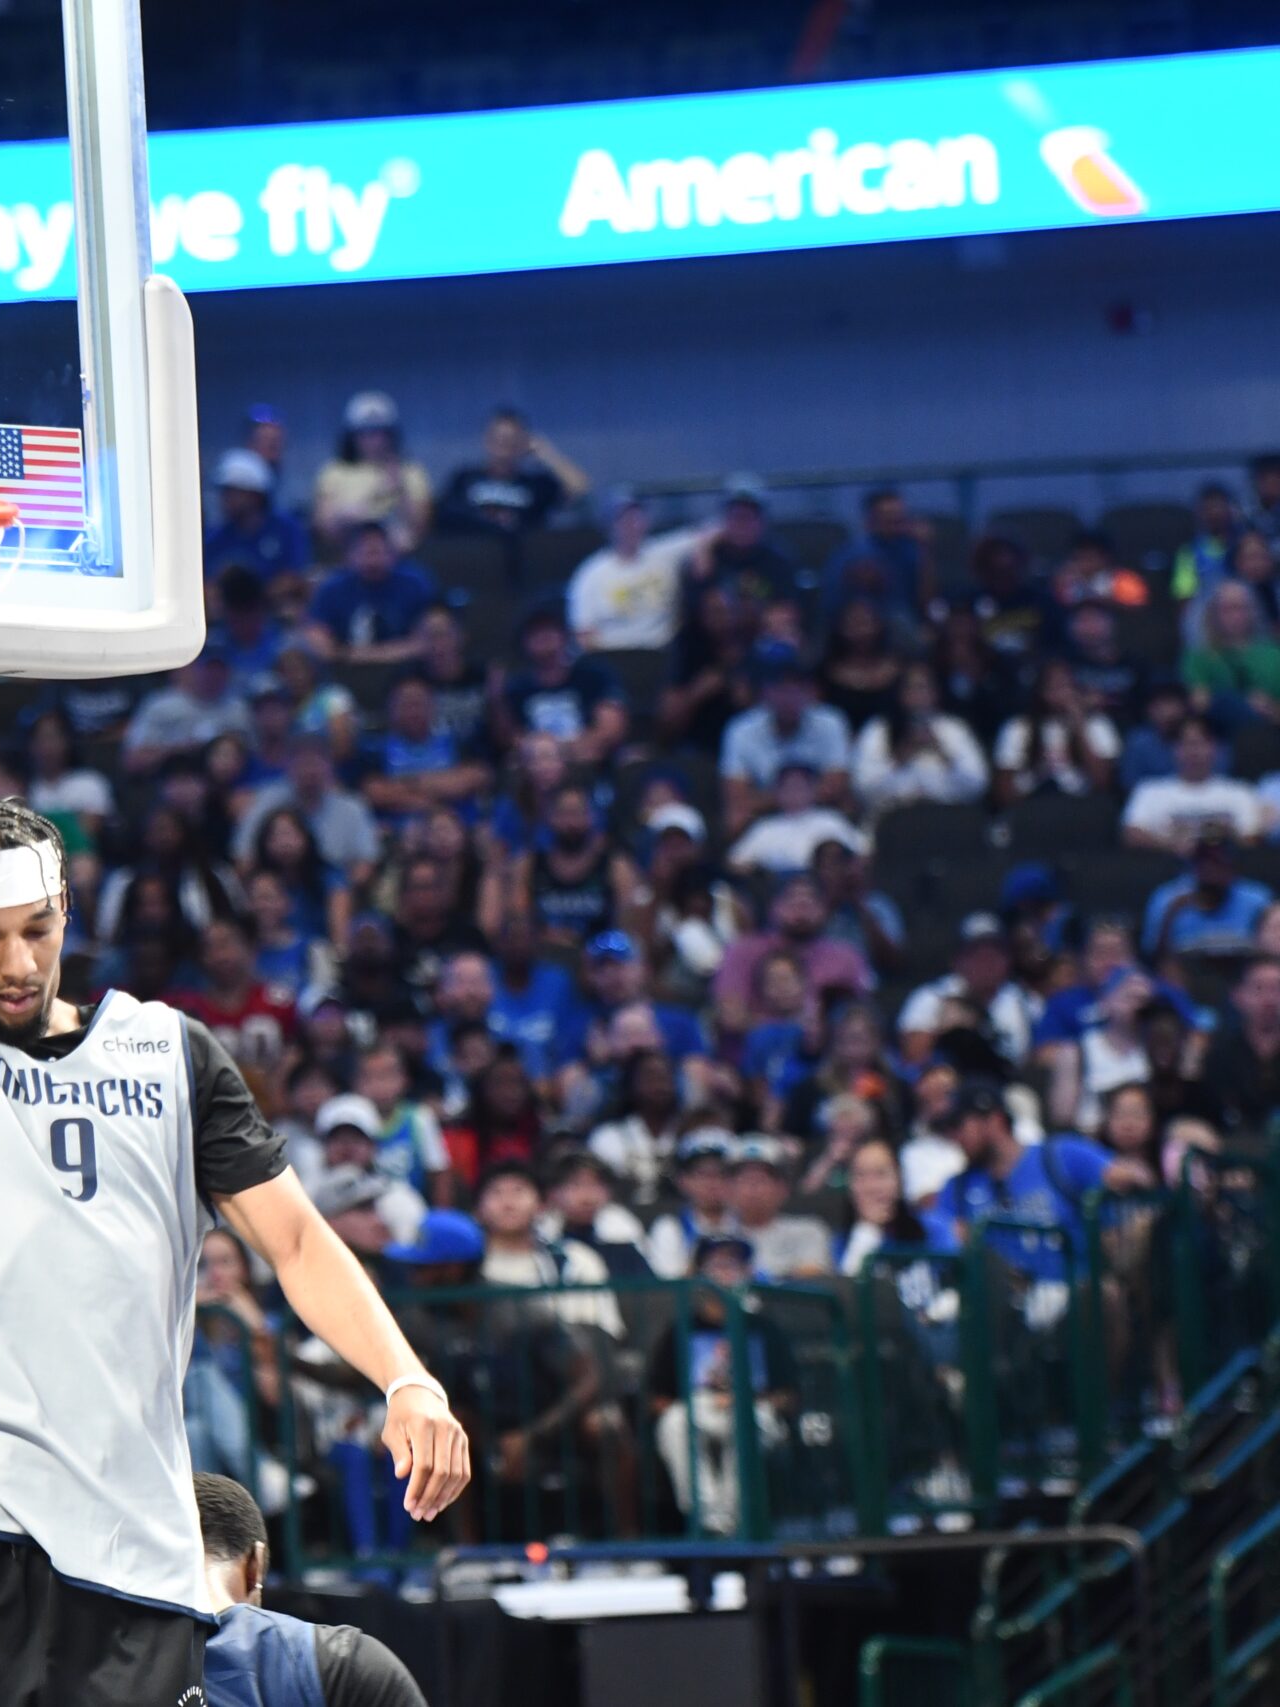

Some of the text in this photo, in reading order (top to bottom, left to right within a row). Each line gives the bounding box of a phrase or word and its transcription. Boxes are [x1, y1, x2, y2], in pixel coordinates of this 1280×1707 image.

[559, 128, 999, 238] American
[103, 1036, 171, 1055] chime
[50, 1117, 98, 1203] 9
